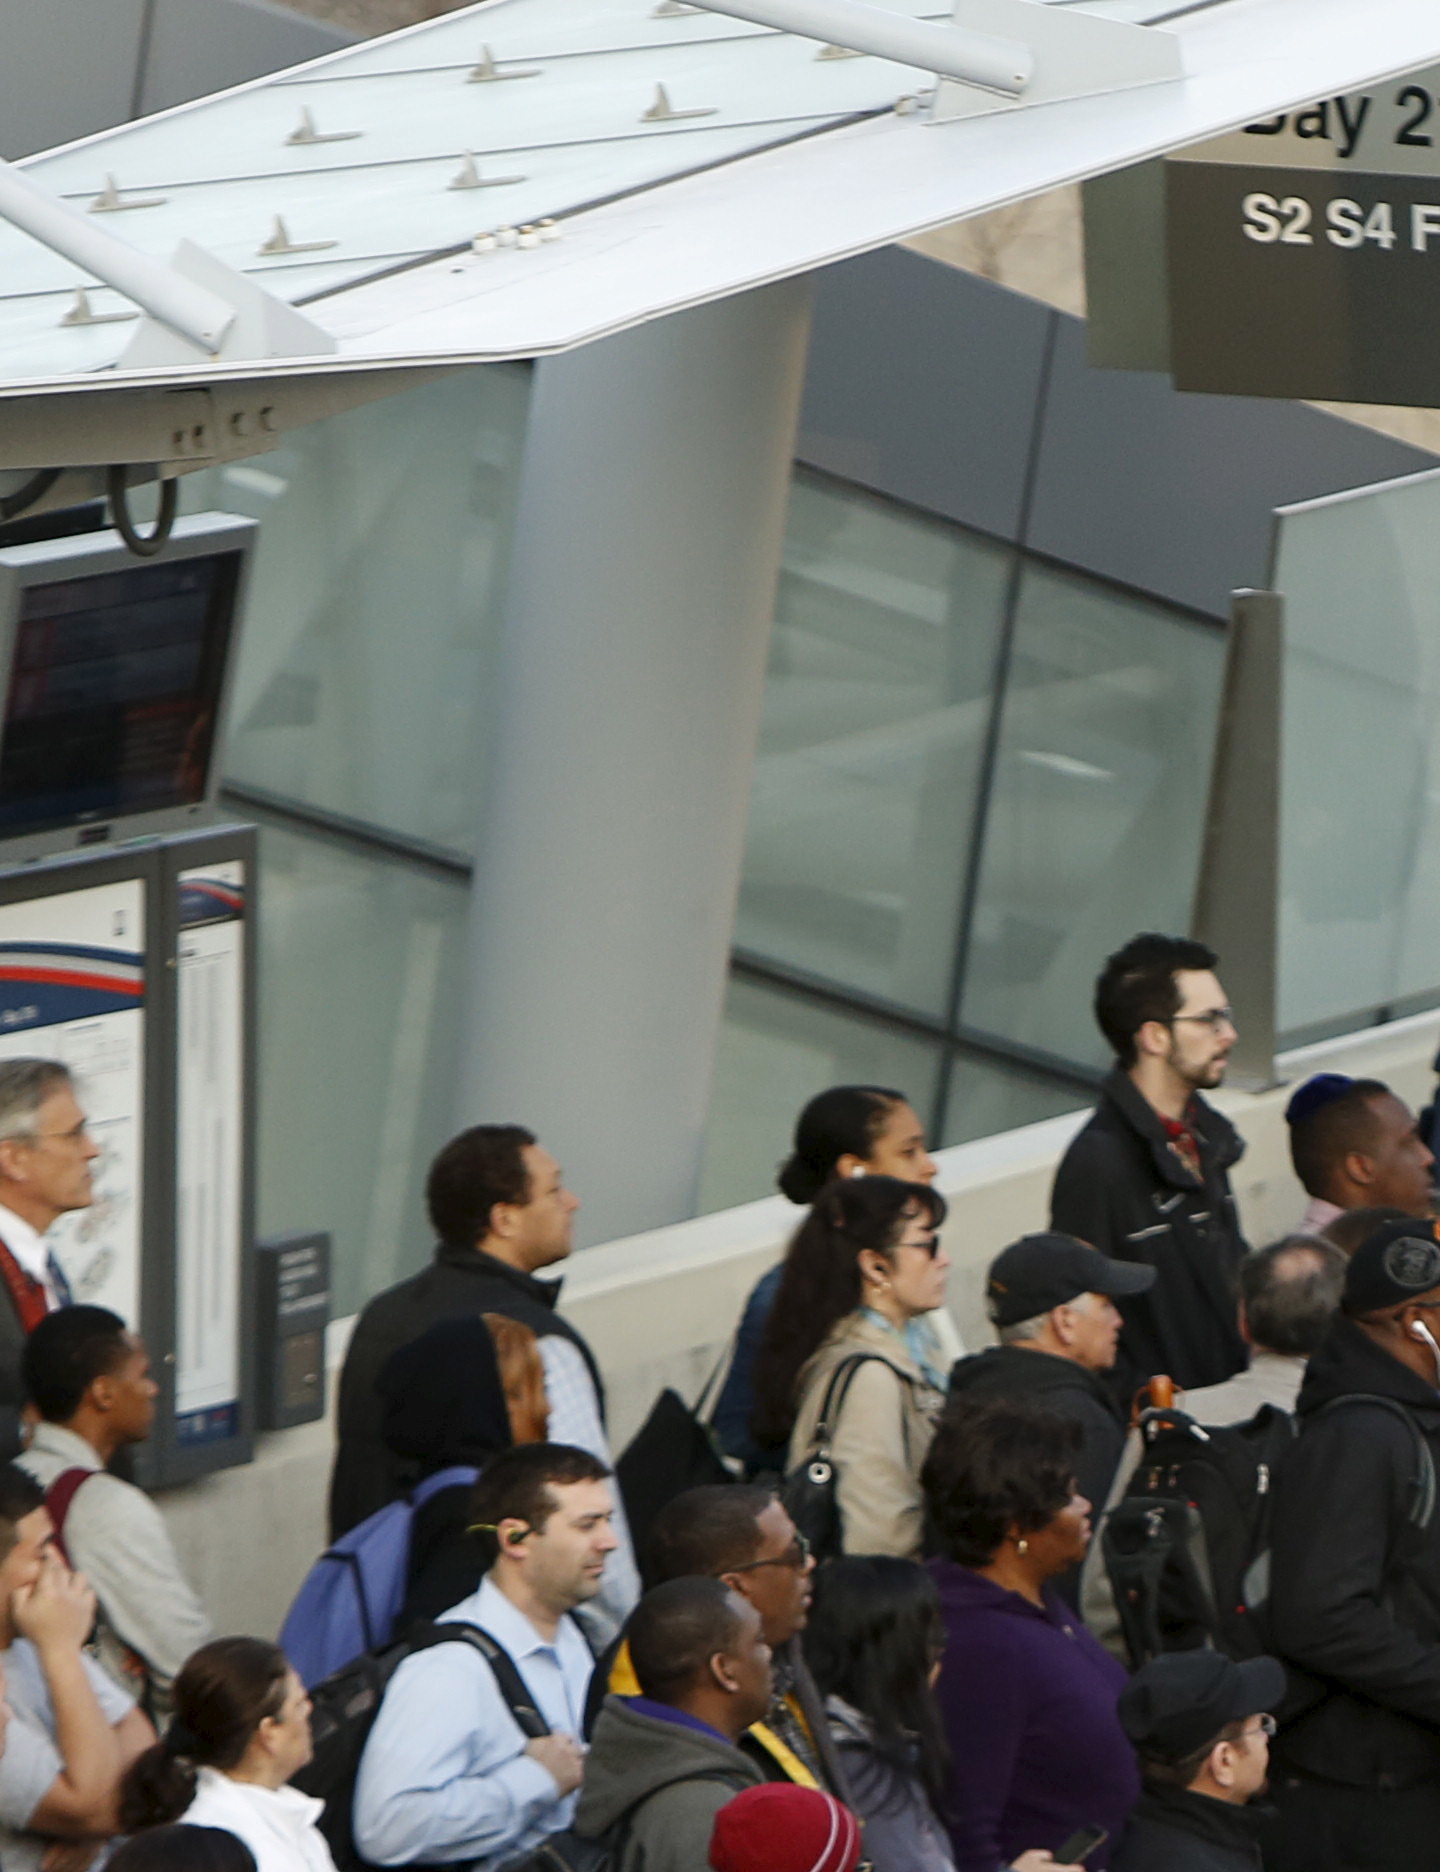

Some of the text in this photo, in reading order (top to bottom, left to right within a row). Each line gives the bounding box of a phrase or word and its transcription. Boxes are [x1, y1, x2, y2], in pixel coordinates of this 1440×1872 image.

[1244, 95, 1372, 159] ay
[1242, 192, 1314, 244] S2
[1326, 198, 1397, 249] S4
